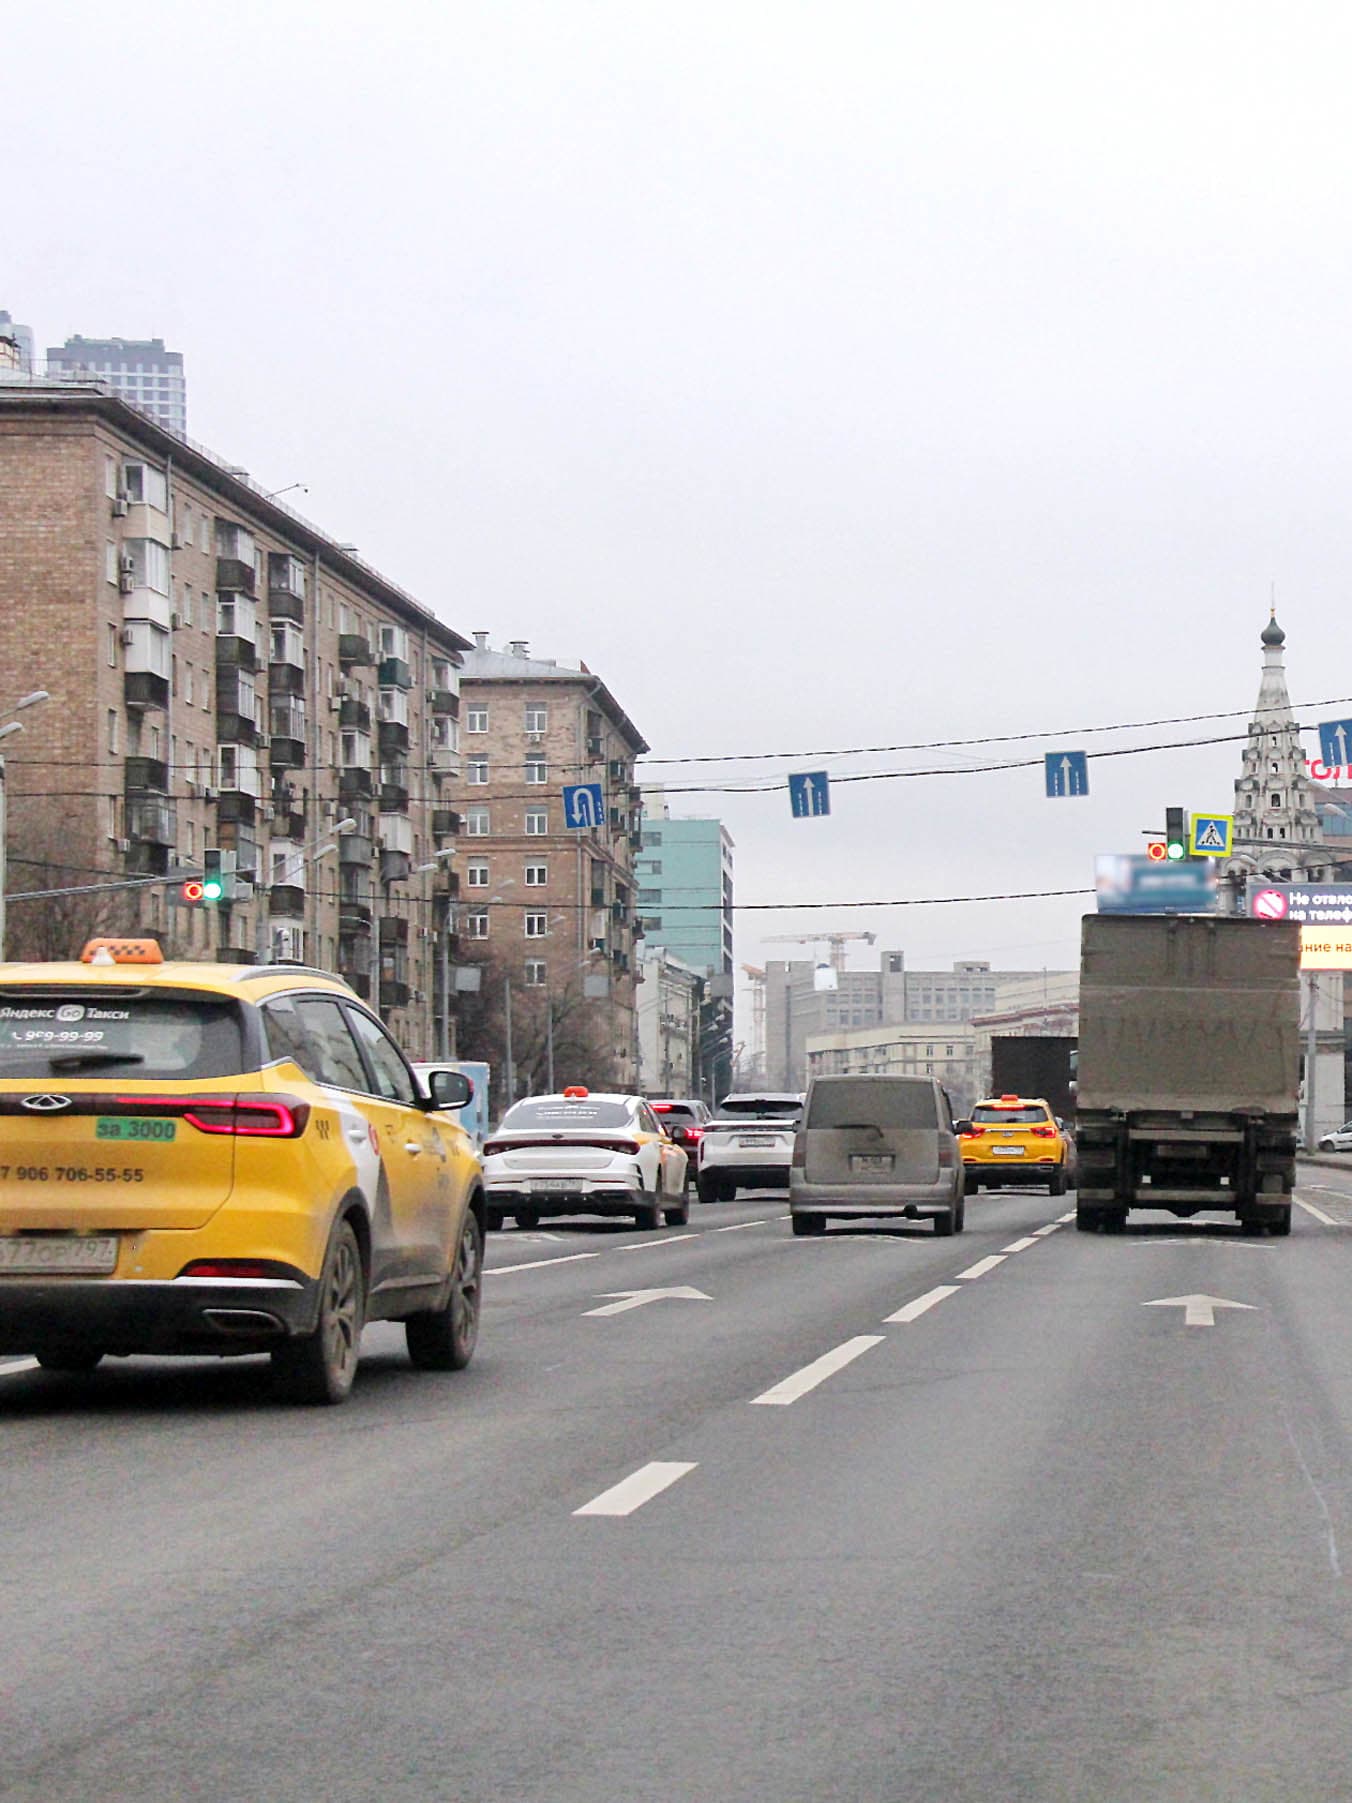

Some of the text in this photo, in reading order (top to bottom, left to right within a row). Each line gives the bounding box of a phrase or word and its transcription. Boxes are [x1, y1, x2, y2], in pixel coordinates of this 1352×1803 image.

[1289, 892, 1310, 905] Не
[1289, 910, 1307, 920] на
[1336, 943, 1352, 953] на
[0, 1006, 56, 1020] Яндекс
[86, 1007, 130, 1020] Такси
[97, 1120, 176, 1139] за 3000
[16, 1166, 49, 1182] 906
[55, 1166, 144, 1183] 706-55-55
